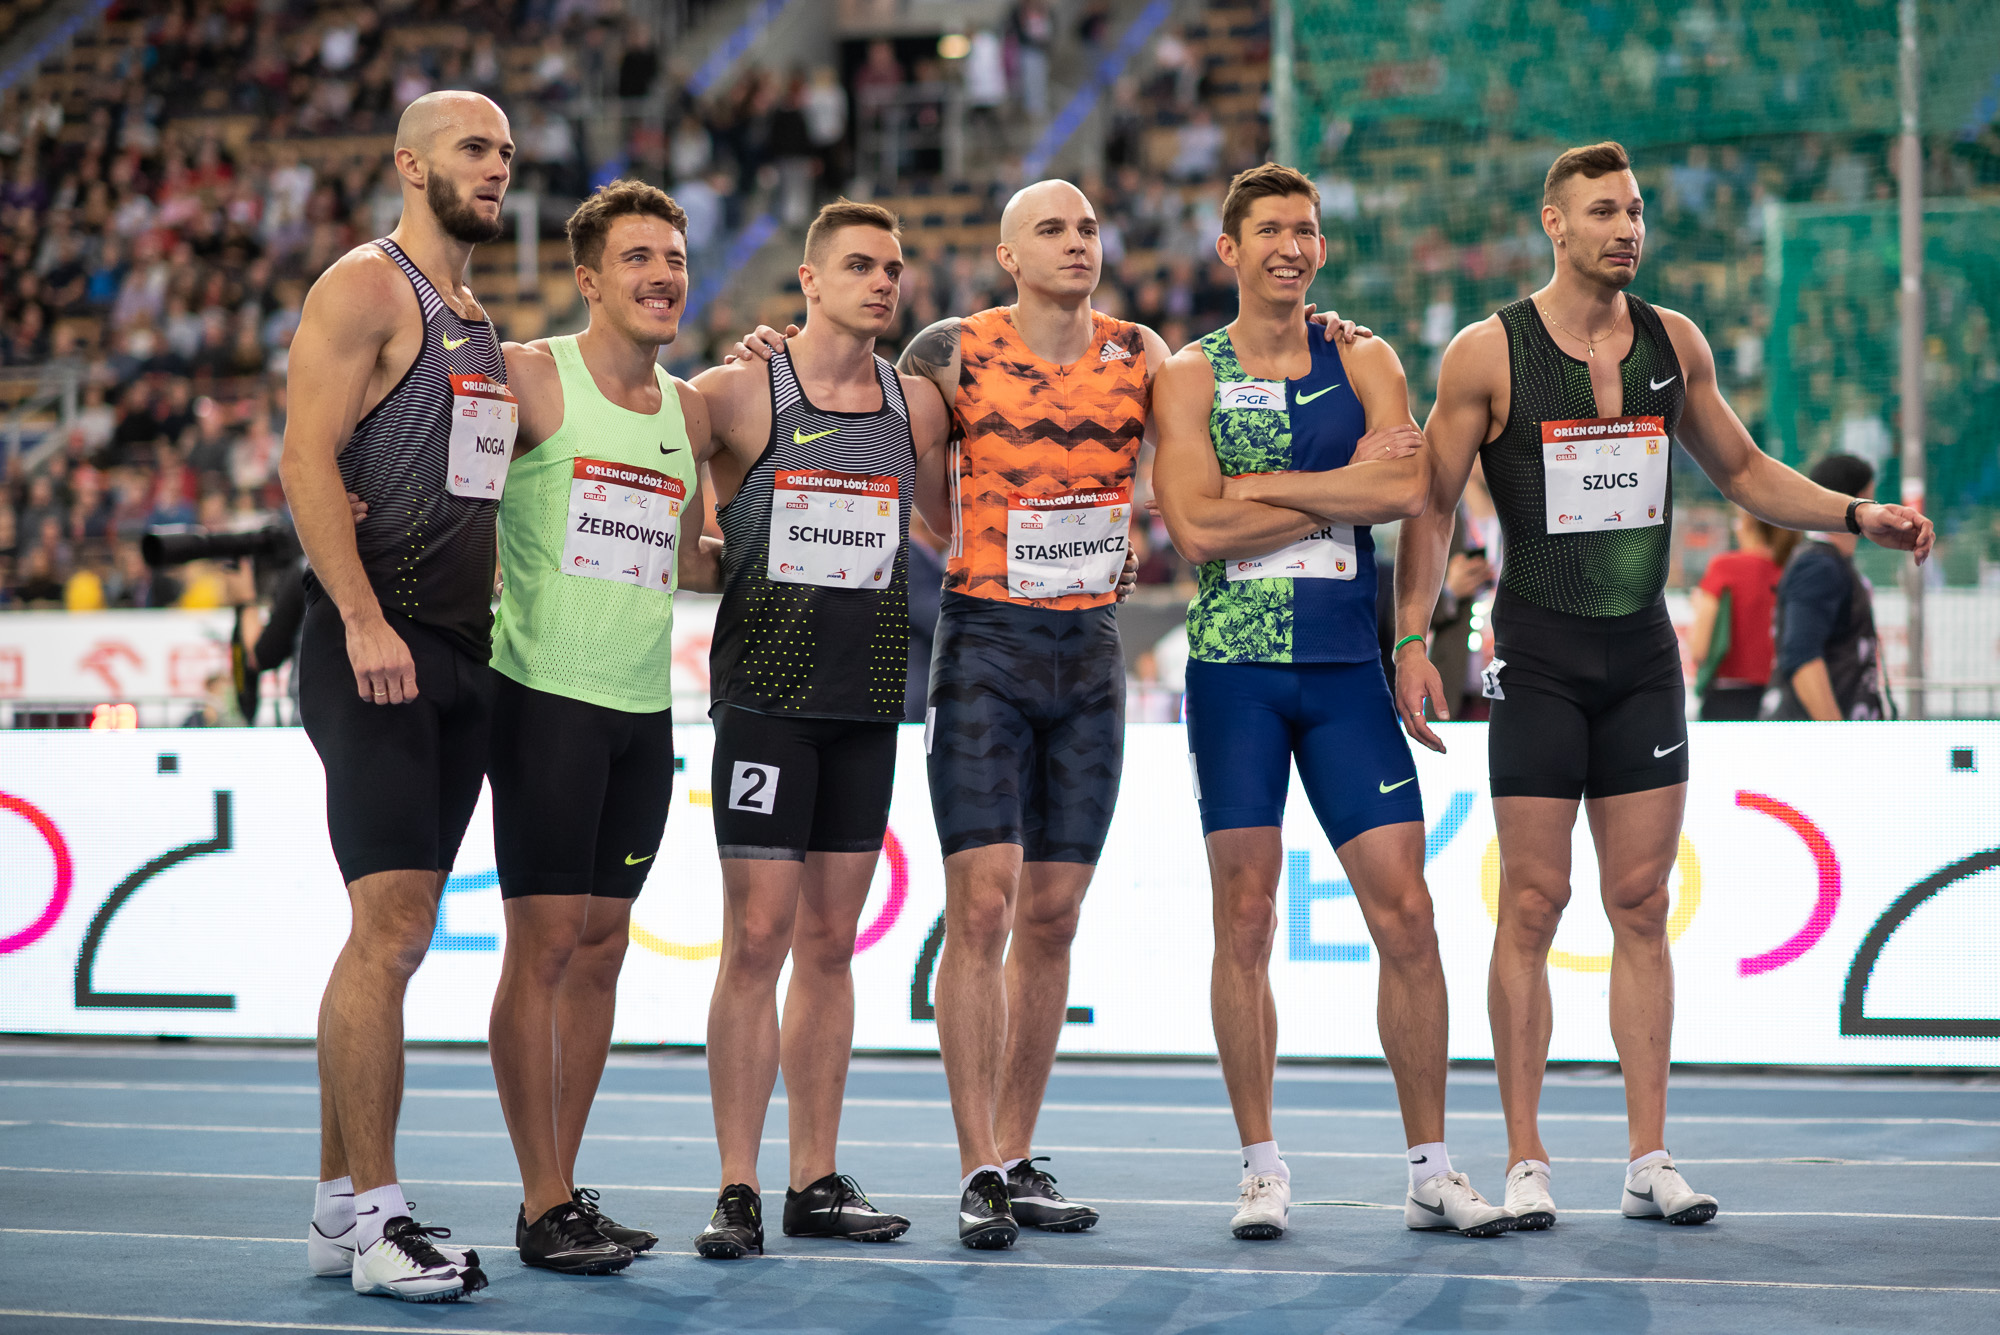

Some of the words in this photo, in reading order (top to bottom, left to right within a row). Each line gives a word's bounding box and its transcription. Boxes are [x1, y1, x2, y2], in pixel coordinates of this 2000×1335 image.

[1100, 350, 1132, 363] adidas
[463, 381, 487, 393] ORLEN
[1236, 395, 1269, 405] PGE
[1554, 427, 1587, 438] ORLEN
[1588, 427, 1606, 435] CUP
[1608, 422, 1635, 434] ŁÓDŹ
[1636, 423, 1657, 432] 2020
[476, 435, 505, 456] NOGA
[586, 465, 621, 482] ORLEN
[621, 471, 638, 483] CUP
[639, 473, 663, 489] ŁÓDŹ
[664, 481, 681, 494] 2020
[787, 476, 823, 487] ORLEN
[824, 479, 842, 488] CUP
[844, 479, 868, 491] ŁÓDŹ
[869, 483, 890, 493] 2020
[1583, 473, 1638, 491] SZUCS
[585, 493, 606, 502] ORLEN
[1020, 498, 1054, 506] ORLEN
[1055, 497, 1074, 506] CUP
[1099, 492, 1119, 501] 2020
[789, 526, 886, 549] SCHUBERT
[1015, 536, 1125, 560] STASKIEWICZ
[737, 767, 767, 809] 2
